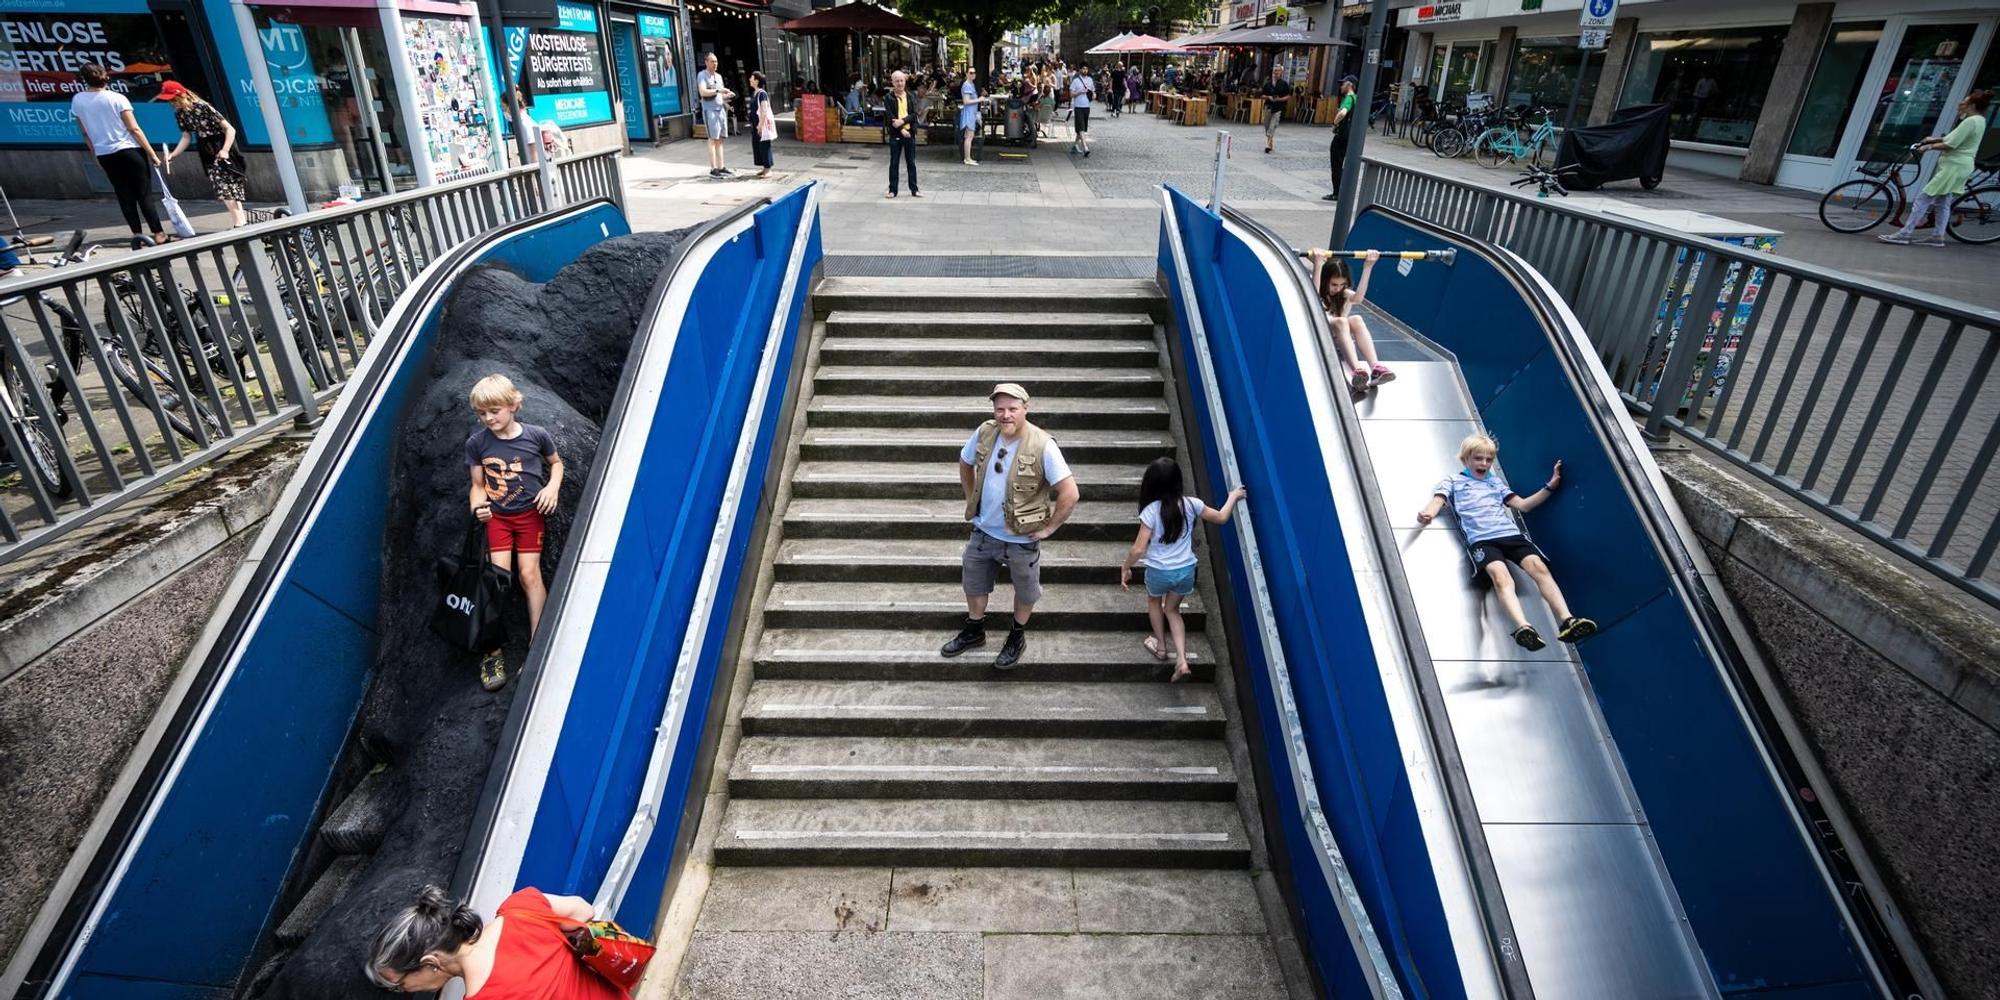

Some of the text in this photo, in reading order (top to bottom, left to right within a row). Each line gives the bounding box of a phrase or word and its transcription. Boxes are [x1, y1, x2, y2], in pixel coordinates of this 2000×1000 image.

[258, 28, 299, 52] MT
[529, 33, 588, 52] KOSTENLOSE
[530, 52, 593, 72] BÜRGERTESTS
[26, 79, 55, 93] hier
[537, 77, 546, 88] Ab
[545, 77, 562, 88] sofort
[561, 77, 572, 87] hier
[9, 108, 77, 122] MEDICA
[15, 125, 81, 136] TESTZENT
